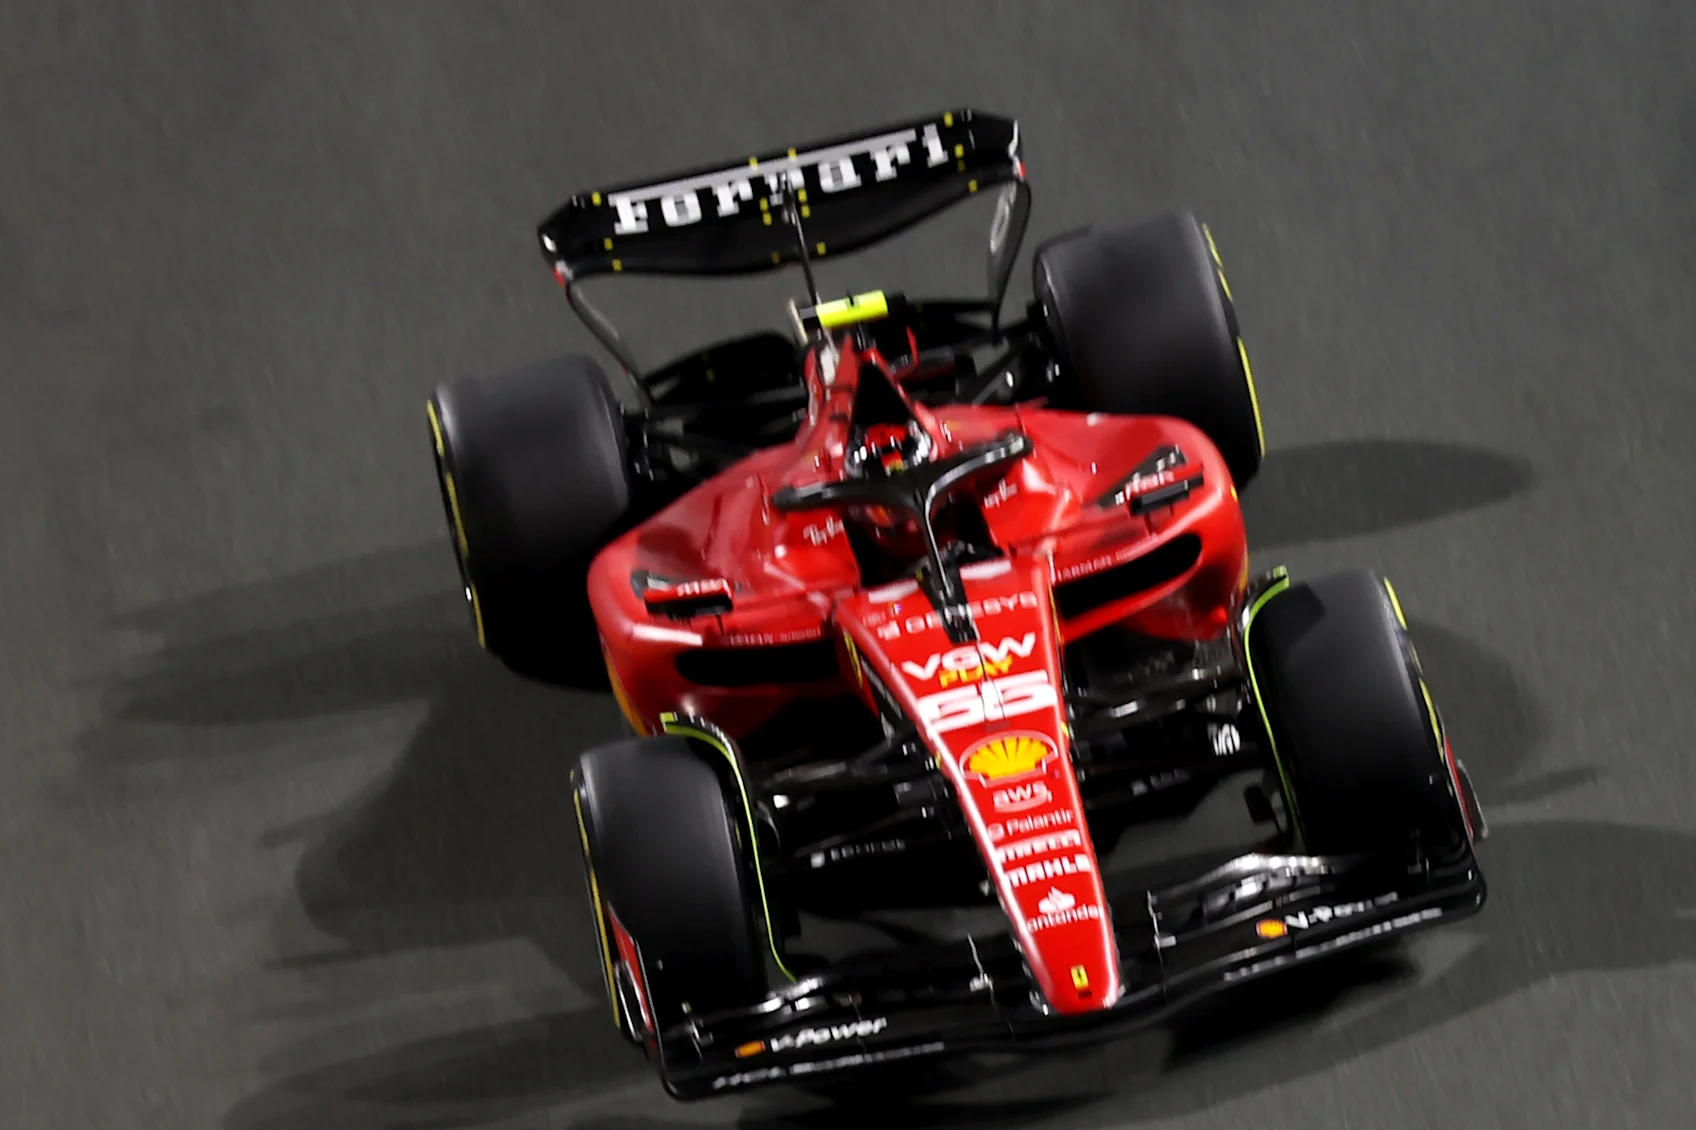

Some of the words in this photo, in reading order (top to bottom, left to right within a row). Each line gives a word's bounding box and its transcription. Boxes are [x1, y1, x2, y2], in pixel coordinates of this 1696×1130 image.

[607, 122, 949, 235] Ferrari
[905, 590, 1038, 636] GEESYS
[901, 632, 1036, 681] VGW
[938, 655, 1013, 689] PLAY
[992, 780, 1051, 810] aws
[1006, 807, 1074, 836] Palantir
[1004, 853, 1092, 889] MAHLE
[770, 1016, 888, 1053] V-Power
